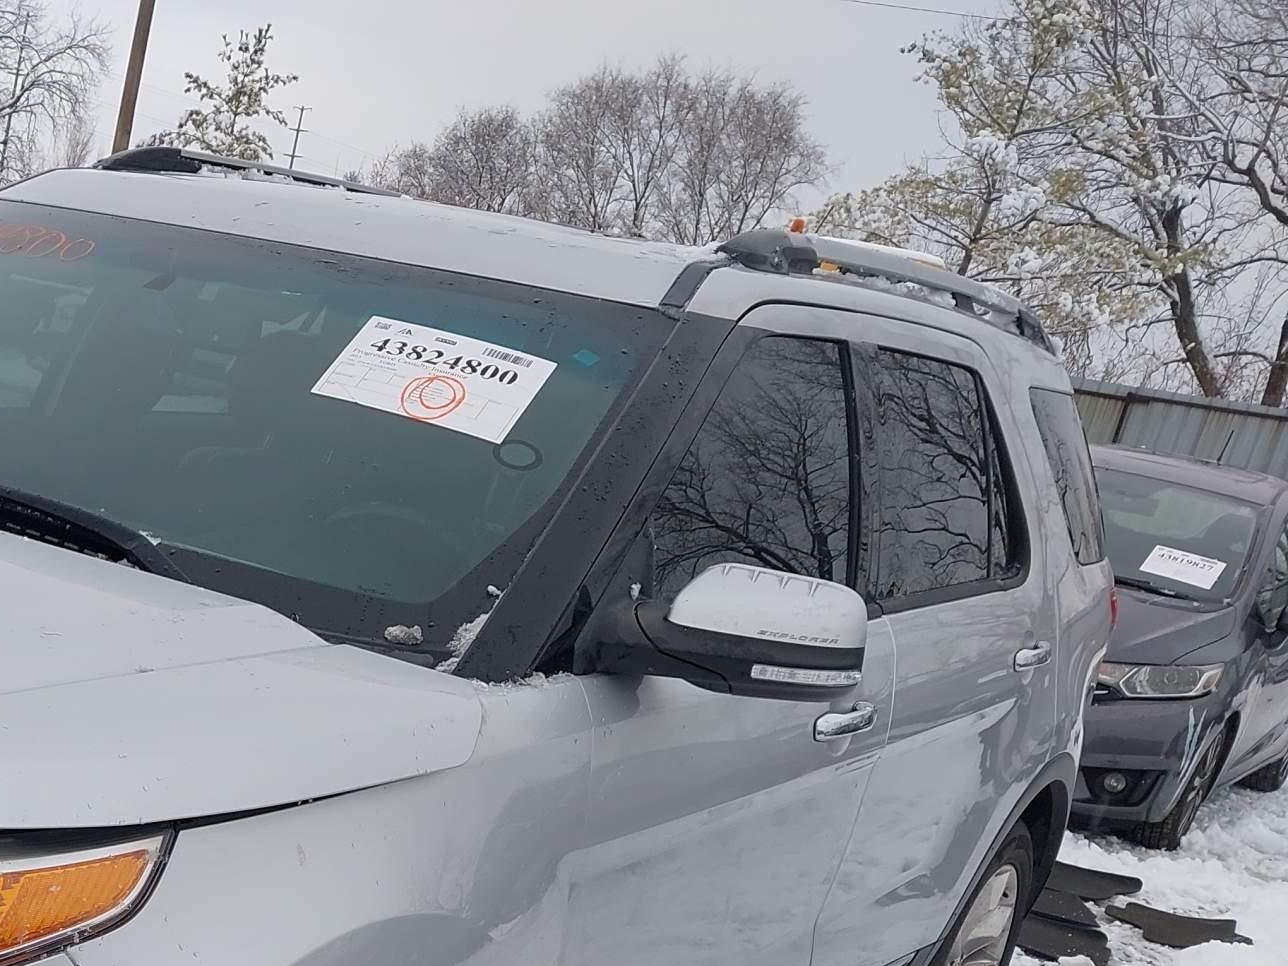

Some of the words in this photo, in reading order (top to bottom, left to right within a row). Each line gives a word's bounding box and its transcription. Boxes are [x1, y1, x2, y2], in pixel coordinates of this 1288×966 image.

[370, 338, 518, 385] 43824800
[1158, 553, 1214, 571] 43819827
[758, 630, 840, 644] EXPLORER
